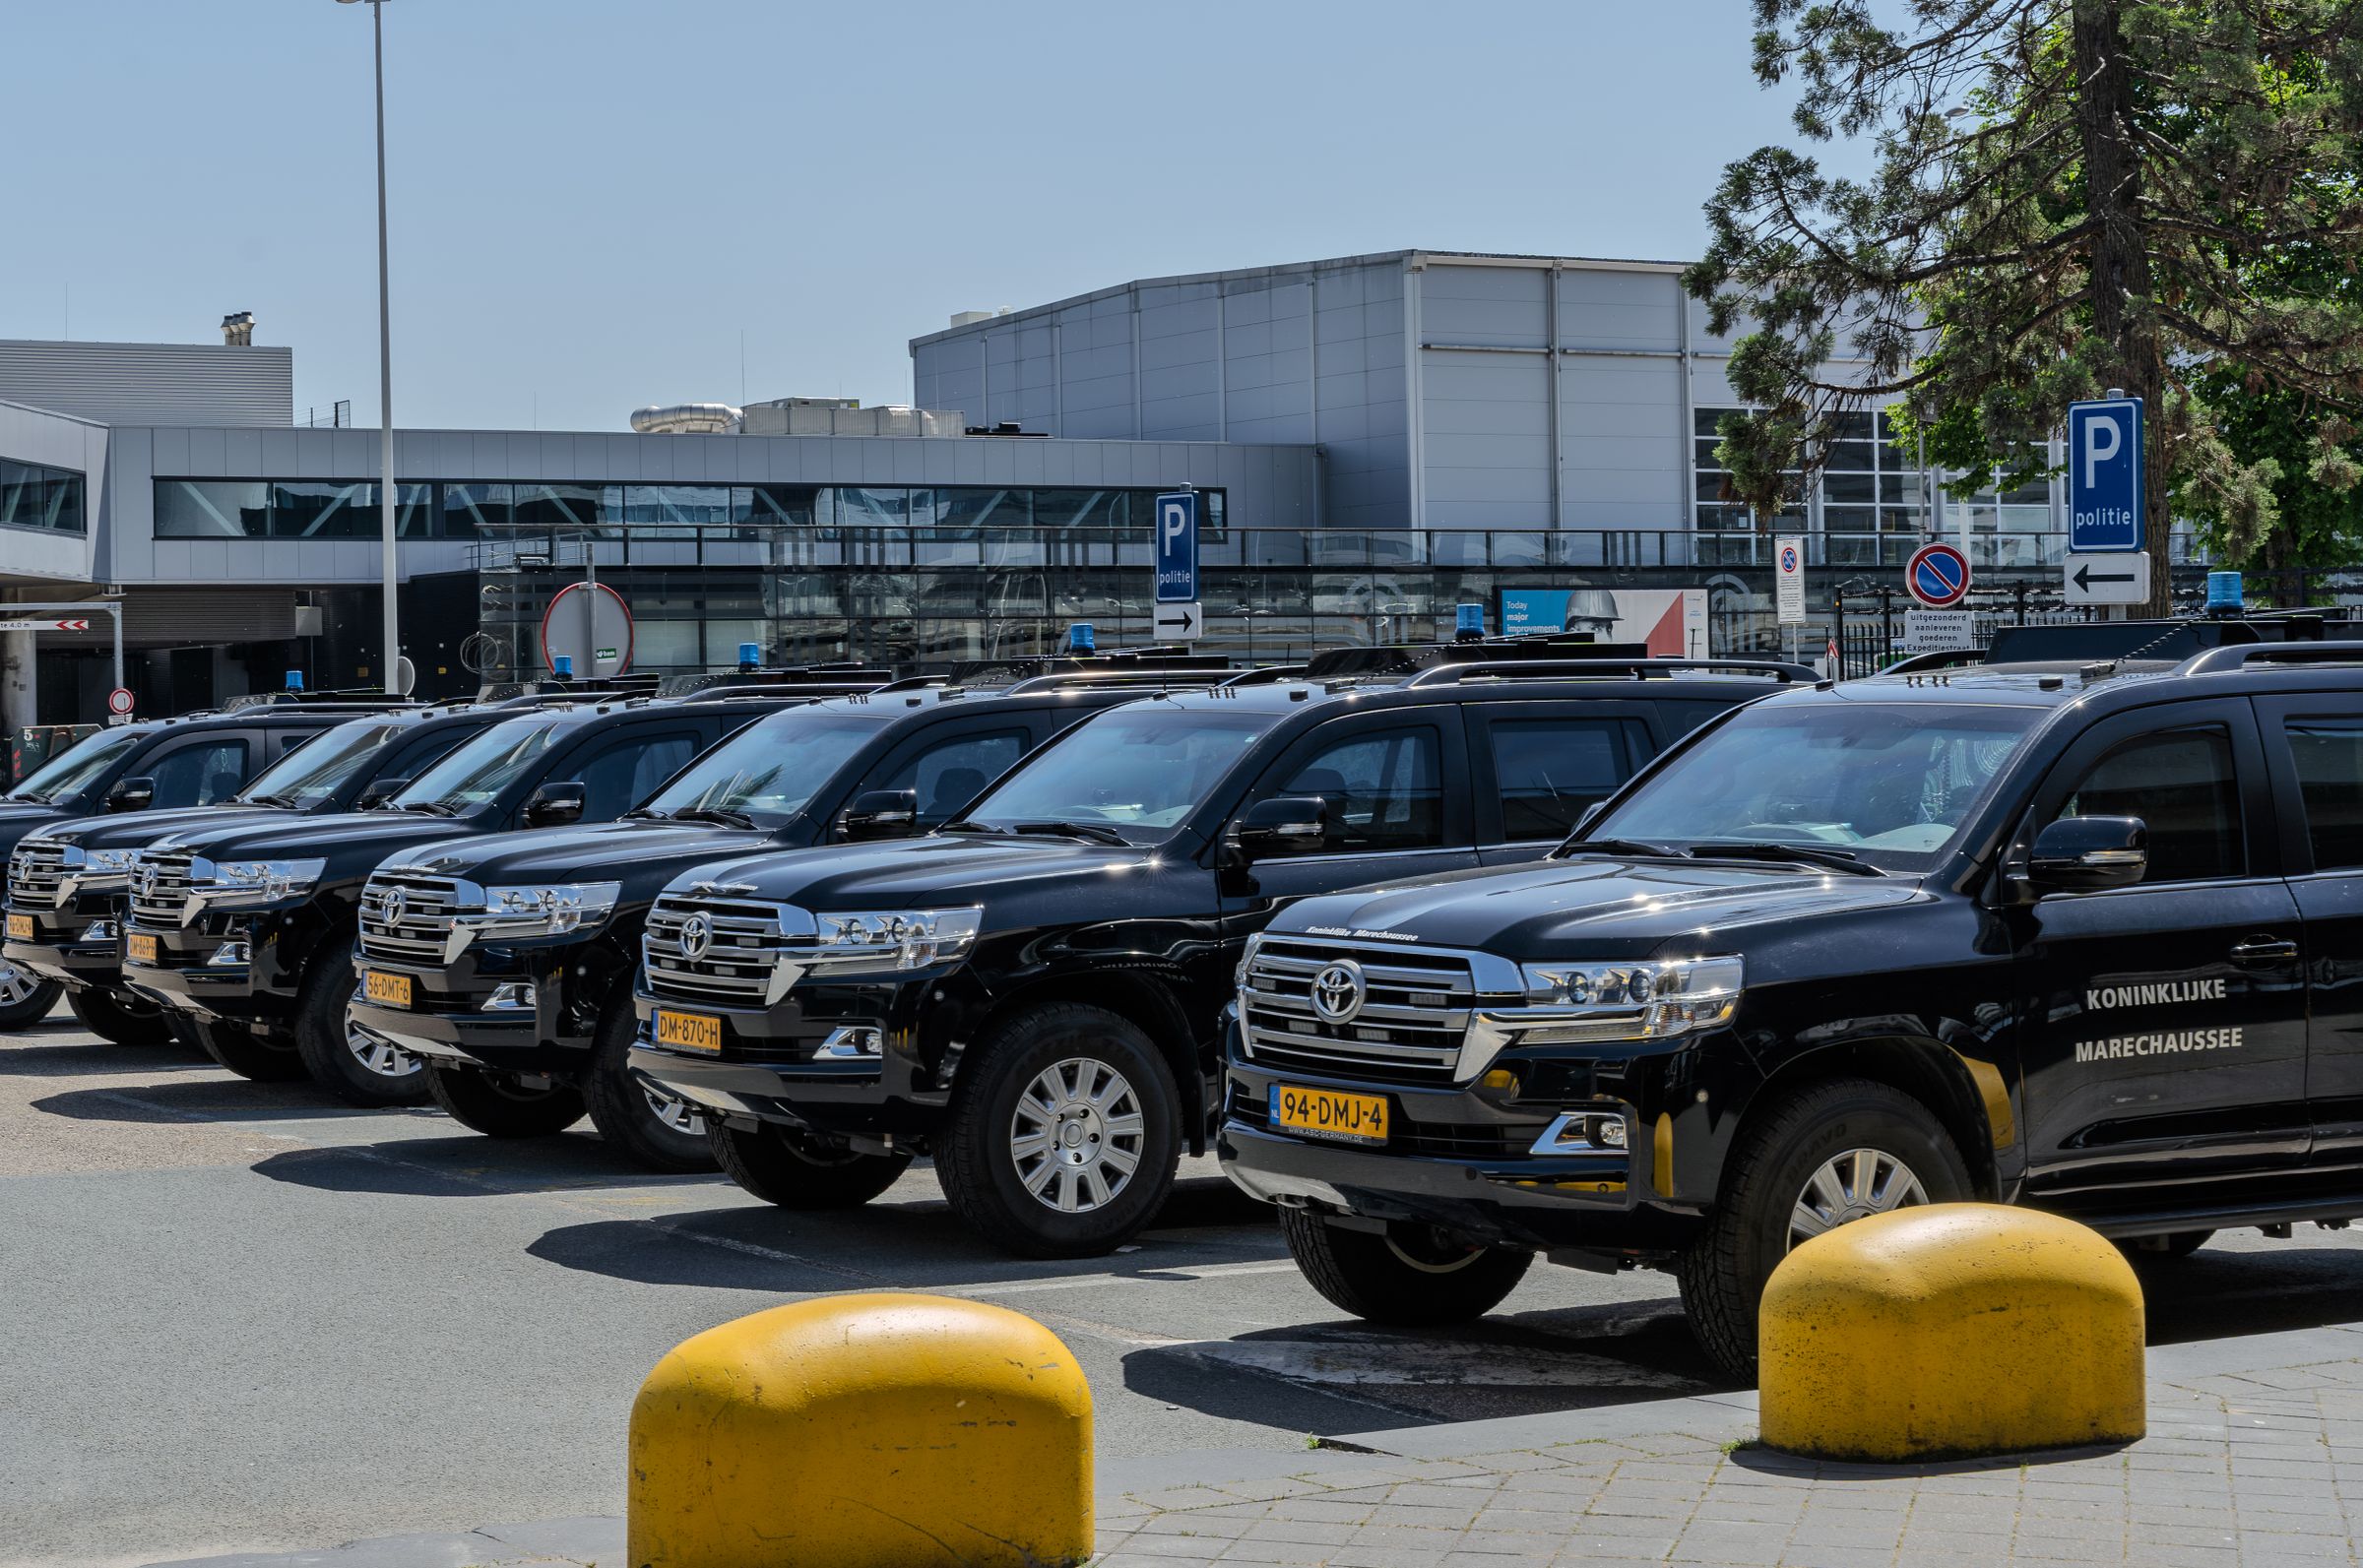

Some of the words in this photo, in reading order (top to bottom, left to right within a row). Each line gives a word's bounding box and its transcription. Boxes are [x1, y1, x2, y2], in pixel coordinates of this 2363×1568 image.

[2084, 415, 2122, 489] P
[1165, 503, 1186, 557] P
[2076, 507, 2132, 531] politie
[1159, 569, 1191, 587] politie
[1506, 600, 1528, 611] Today
[1506, 612, 1529, 623] major
[1506, 624, 1561, 635] improvements
[1910, 613, 1967, 623] uitgezonderd
[1918, 634, 1957, 643] goederen
[368, 975, 410, 1001] 56-DMT-6
[2086, 978, 2226, 1010] KONINKLIJKE
[660, 1015, 719, 1045] DM-870-H
[2075, 1027, 2243, 1063] MARECHAUSSEE
[1271, 1108, 1280, 1119] NL
[1284, 1092, 1382, 1131] 94-DMJ-4
